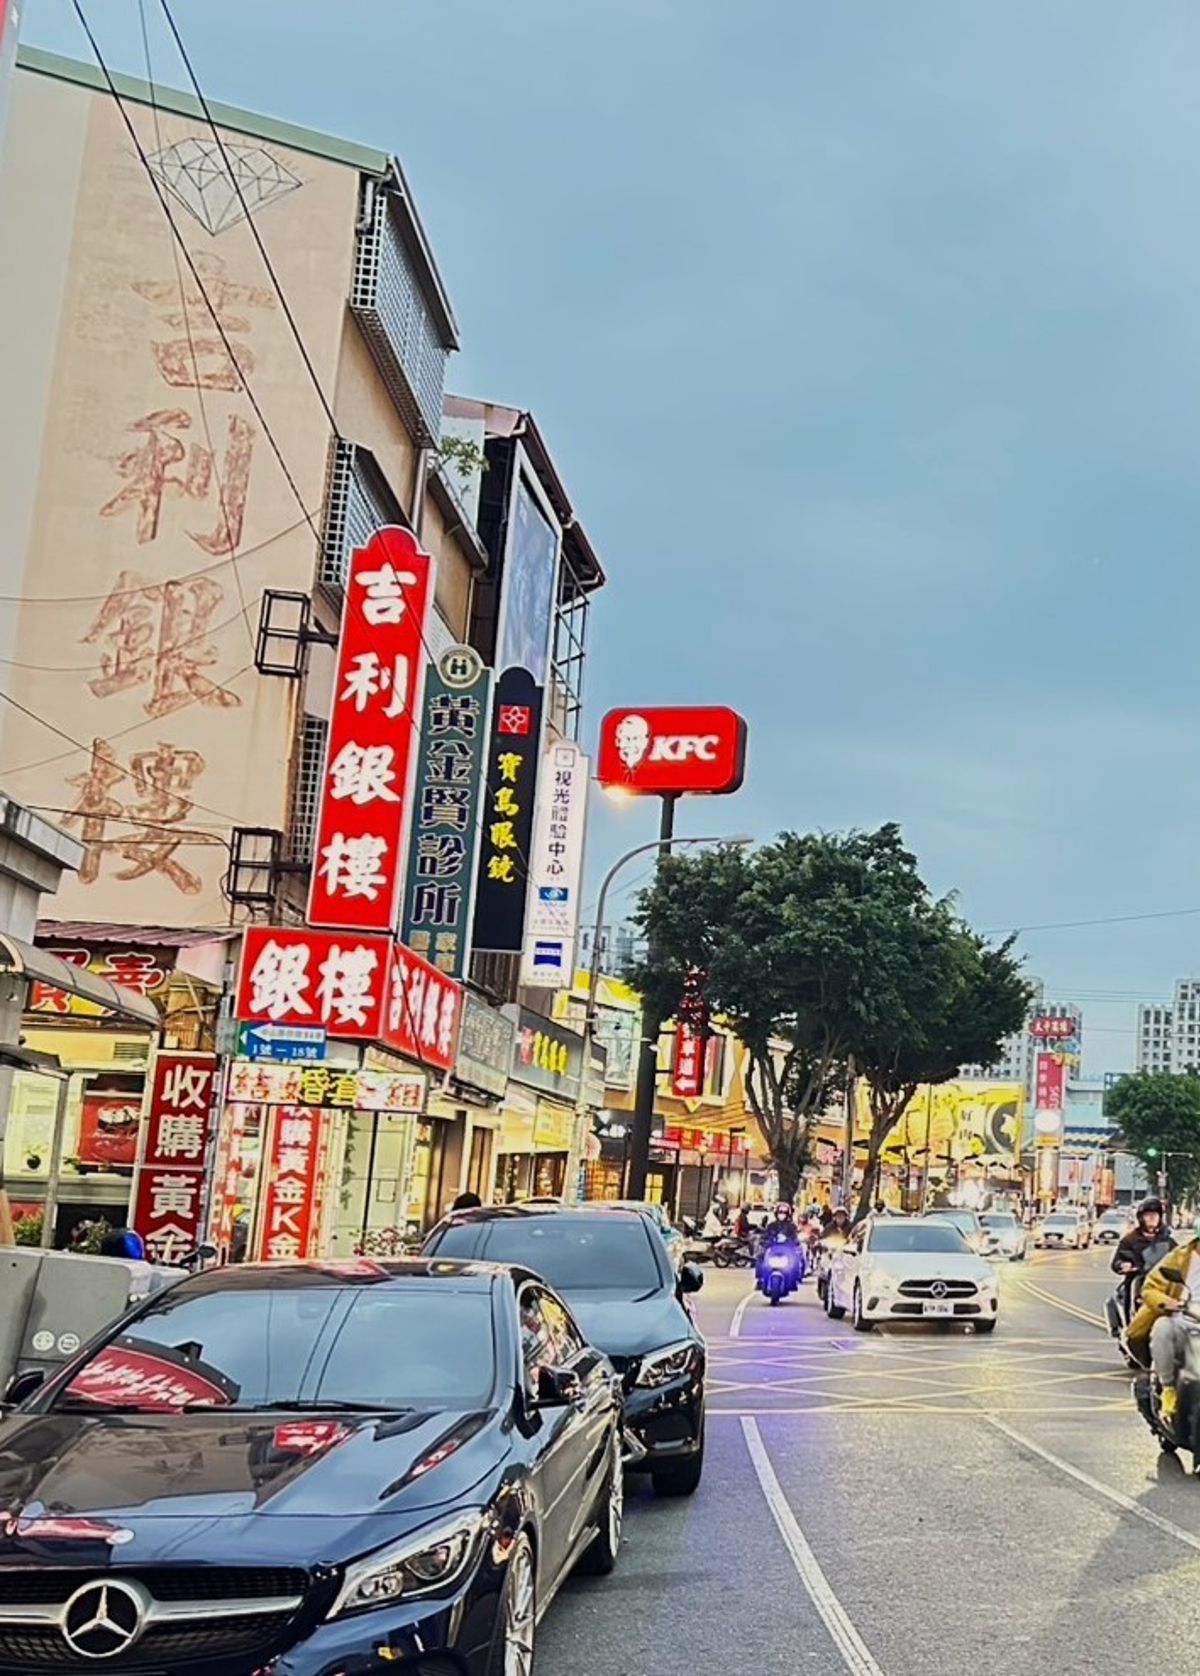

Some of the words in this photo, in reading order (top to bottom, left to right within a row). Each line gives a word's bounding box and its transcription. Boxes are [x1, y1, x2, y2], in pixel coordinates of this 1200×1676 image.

[60, 250, 277, 896] 吉利銀樓
[318, 562, 417, 902] 吉利銀樓
[409, 692, 480, 926] 黃金賢診所
[487, 751, 524, 884] 寶島眼鏡
[650, 734, 719, 761] KFC
[248, 938, 379, 1028] 銀樓
[145, 1064, 210, 1263] 收購黃金
